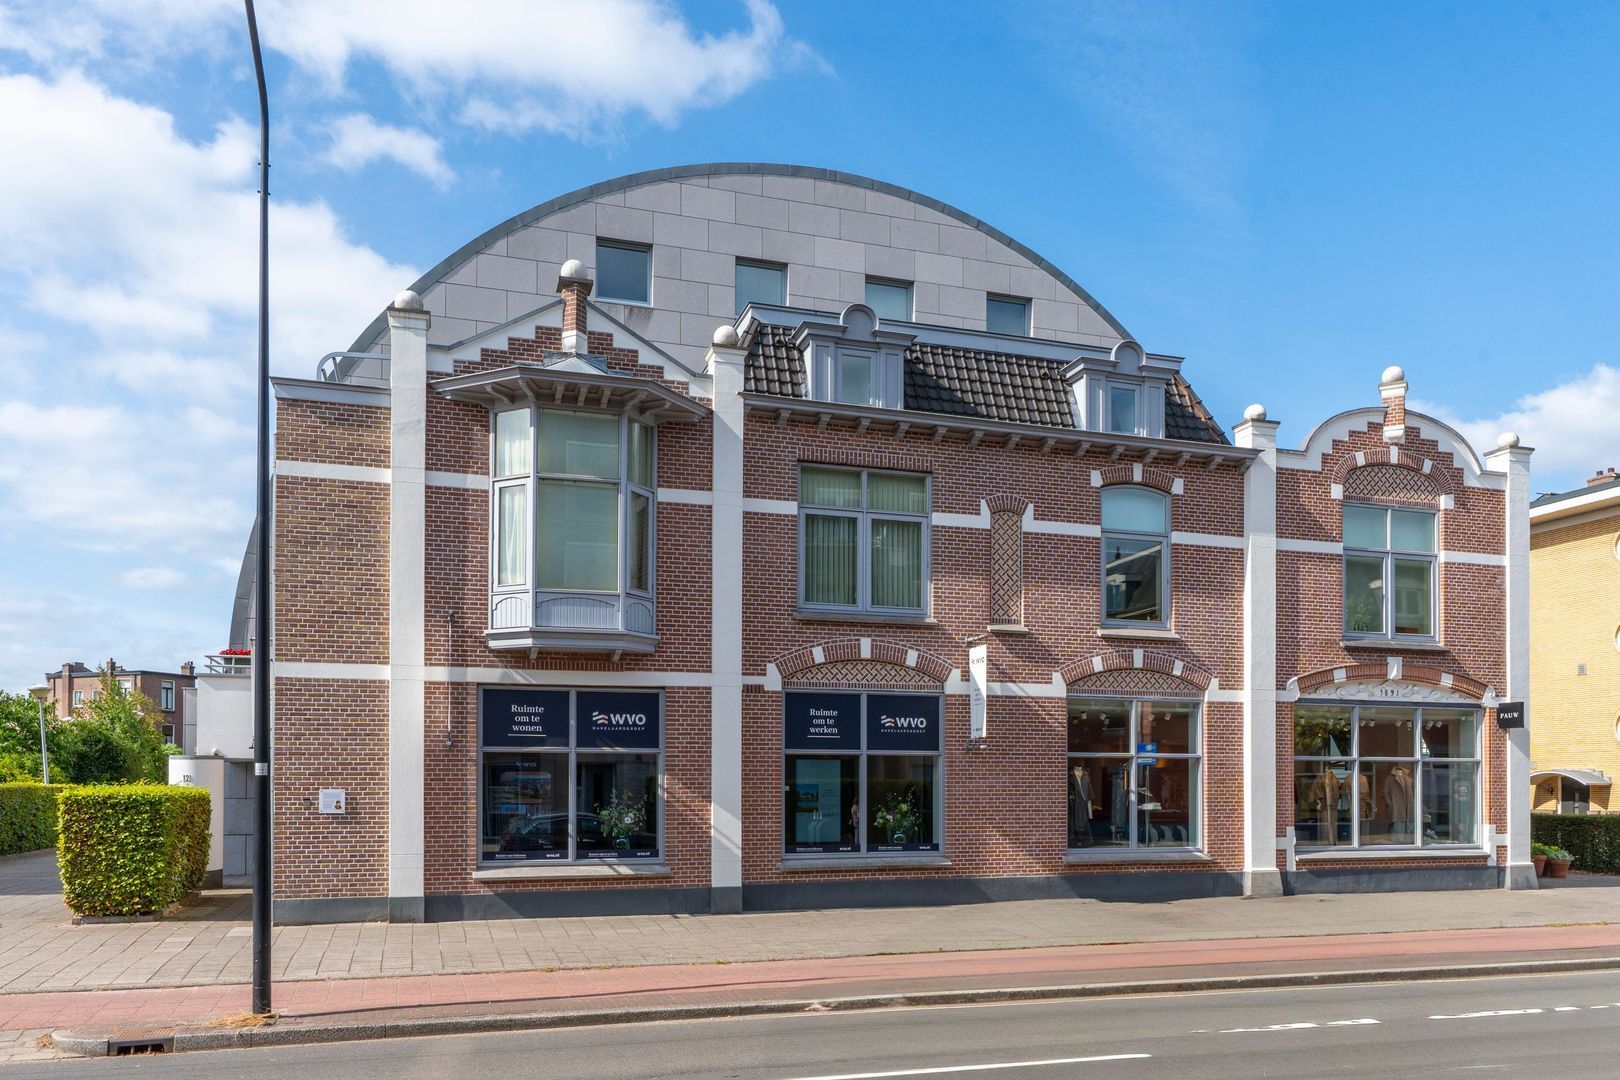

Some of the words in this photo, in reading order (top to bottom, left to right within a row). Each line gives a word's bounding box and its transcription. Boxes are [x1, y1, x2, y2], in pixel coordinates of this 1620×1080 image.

[511, 704, 545, 713] Ruimte
[809, 708, 838, 717] Ruimte
[610, 713, 646, 725] WVO
[896, 717, 927, 728] WVO
[809, 725, 838, 734] werken
